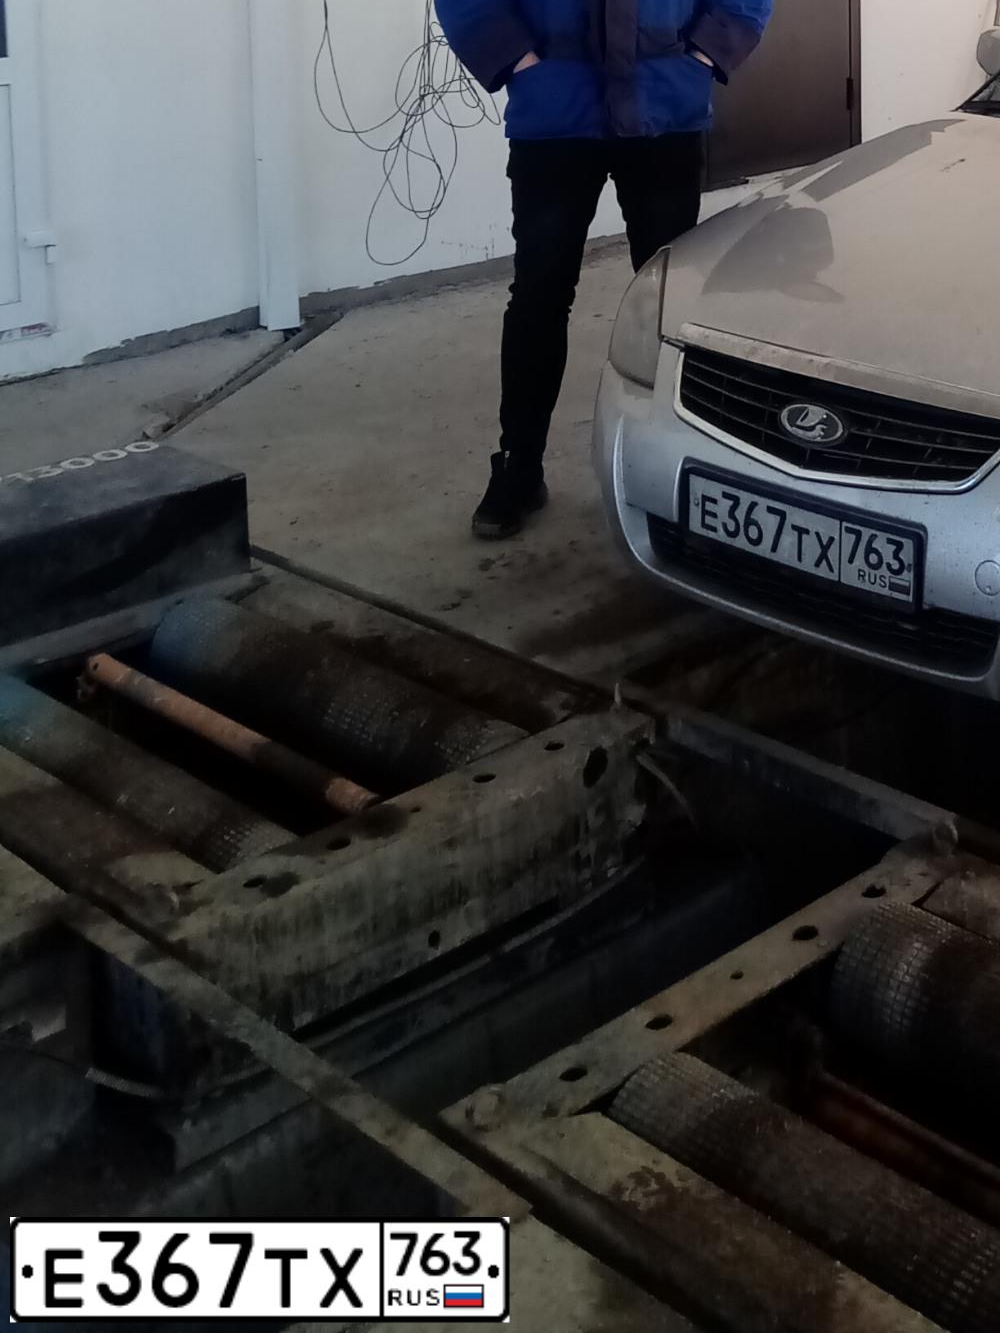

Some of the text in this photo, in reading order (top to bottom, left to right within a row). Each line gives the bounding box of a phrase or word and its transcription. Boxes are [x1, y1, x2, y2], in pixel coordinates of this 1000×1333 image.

[0, 441, 159, 482] 13000
[700, 491, 905, 576] Е367ТХ 763
[858, 569, 887, 588] RUS
